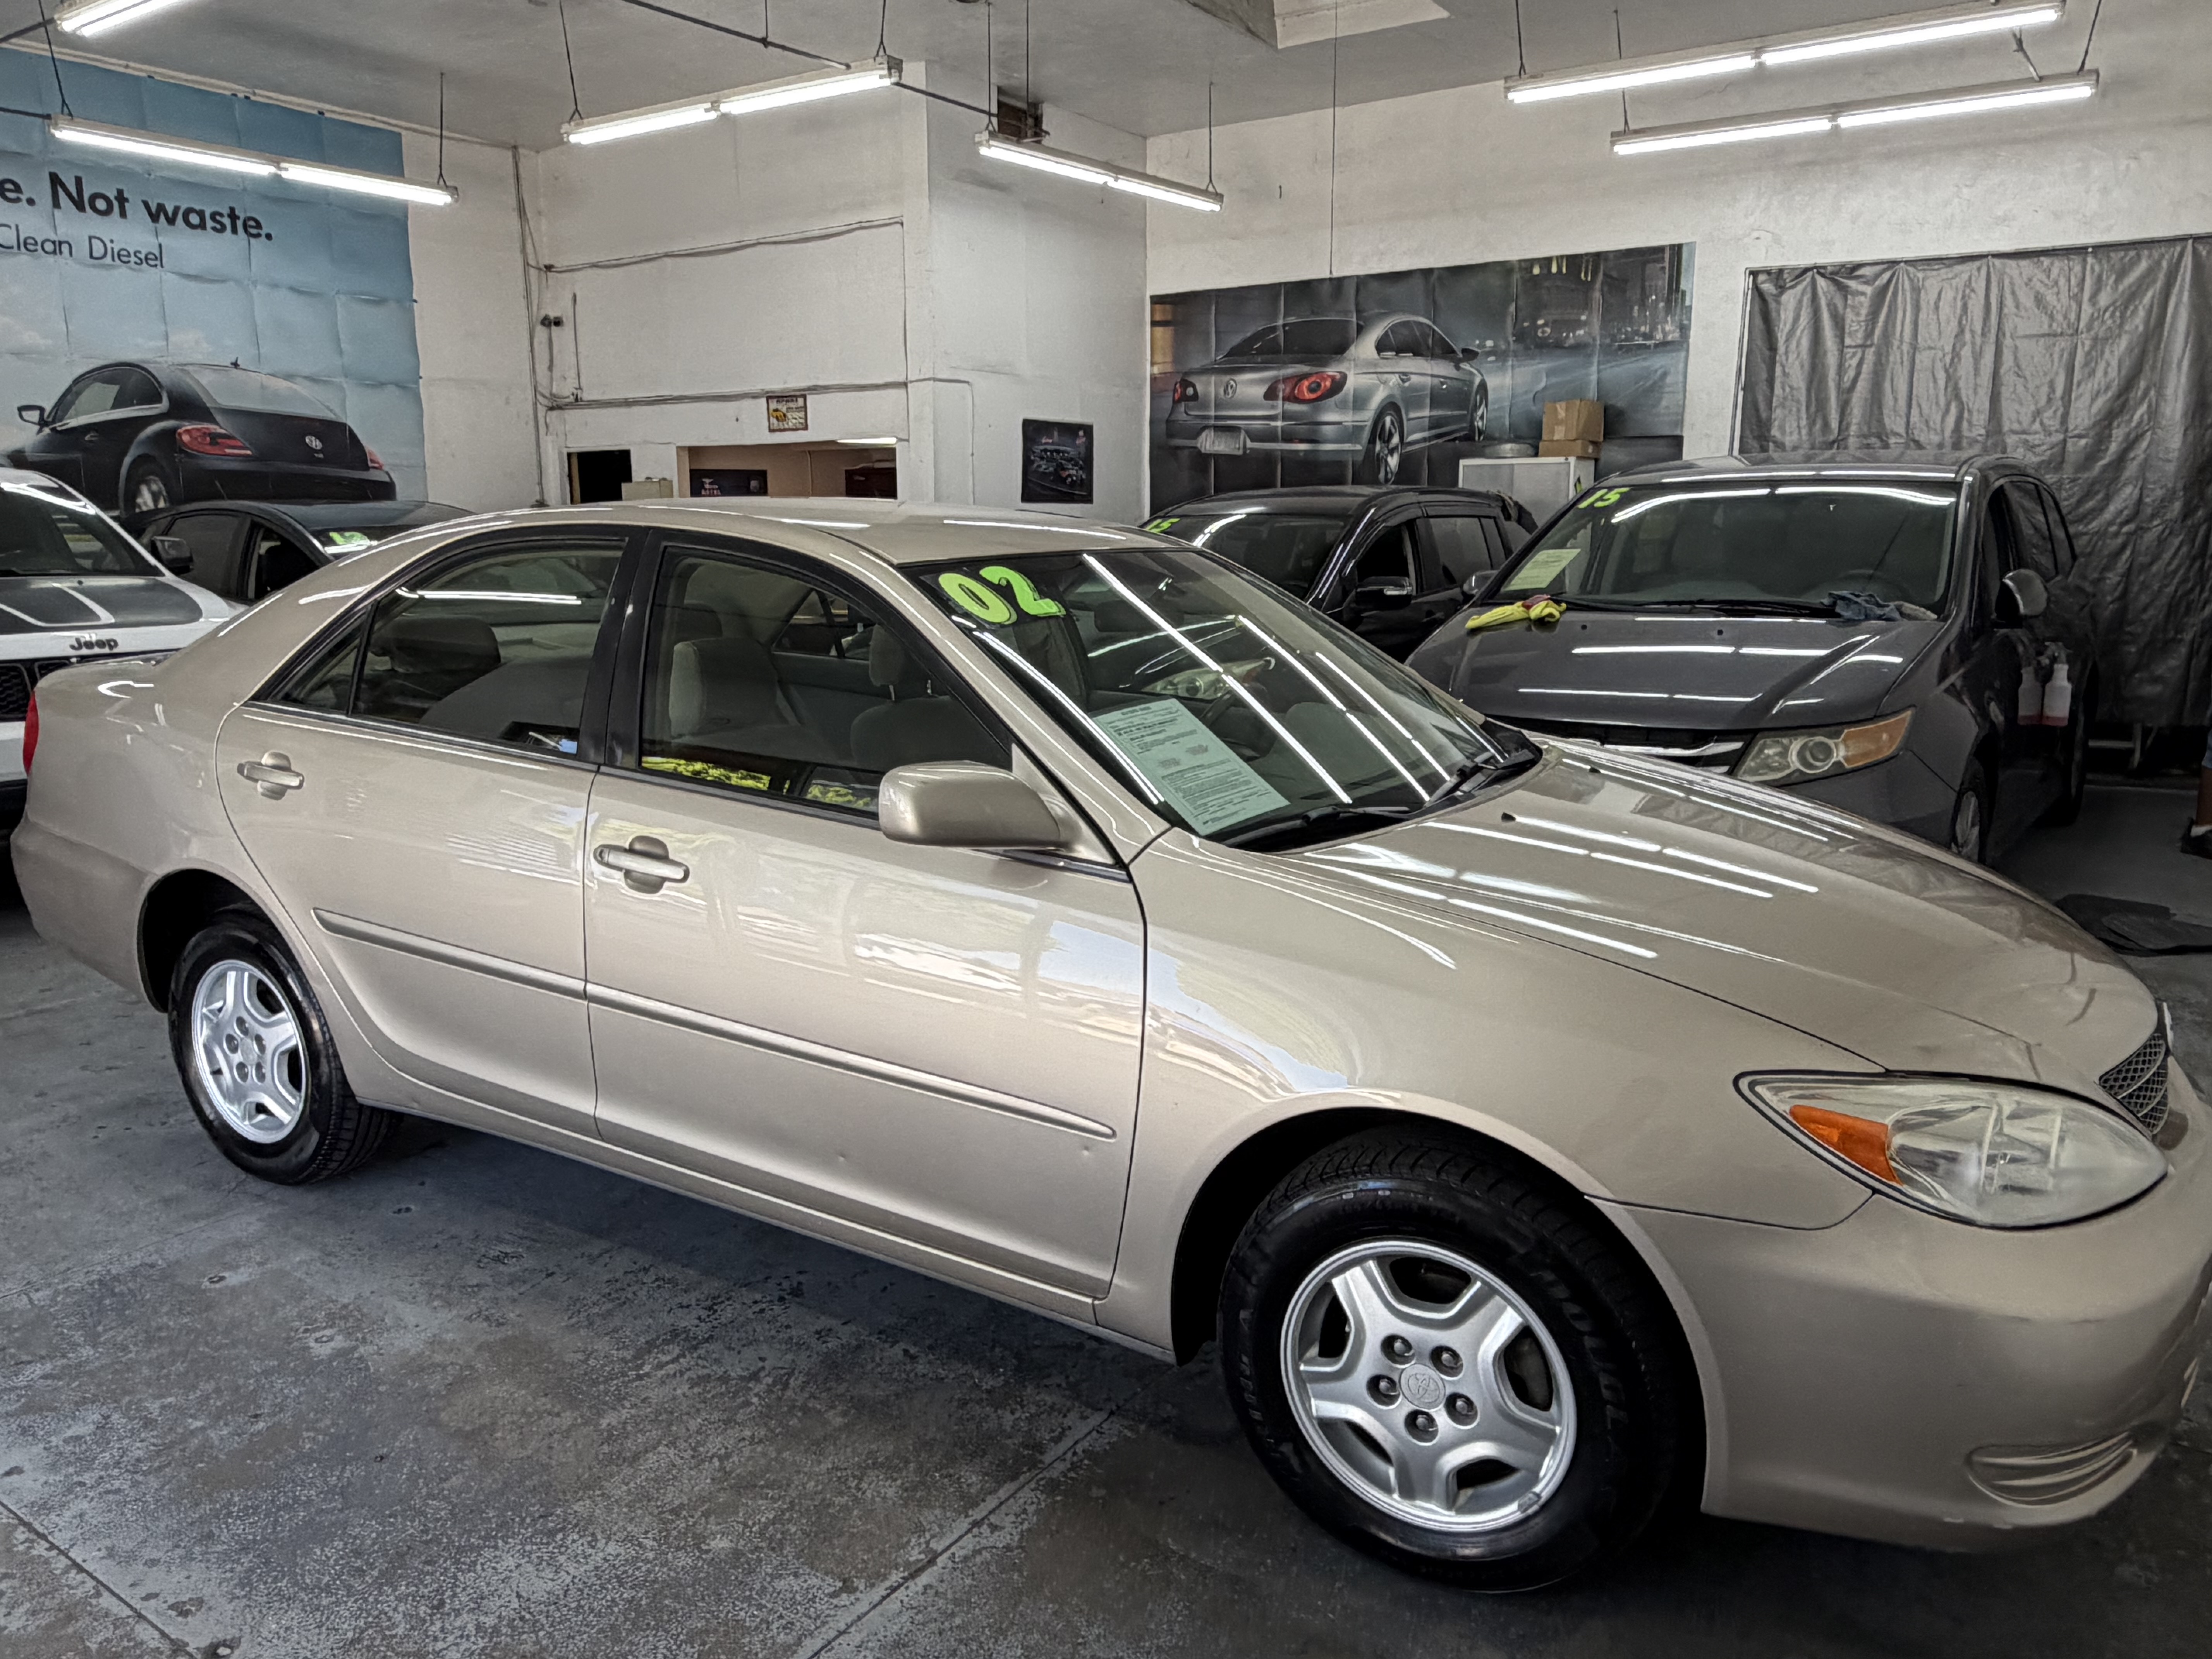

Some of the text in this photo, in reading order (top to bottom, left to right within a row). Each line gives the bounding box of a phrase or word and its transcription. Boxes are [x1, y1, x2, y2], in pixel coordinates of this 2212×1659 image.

[49, 171, 129, 219] Not
[141, 199, 273, 241] waste.
[88, 235, 164, 268] Diesel
[1578, 487, 1631, 508] 15
[939, 565, 1066, 625] 02
